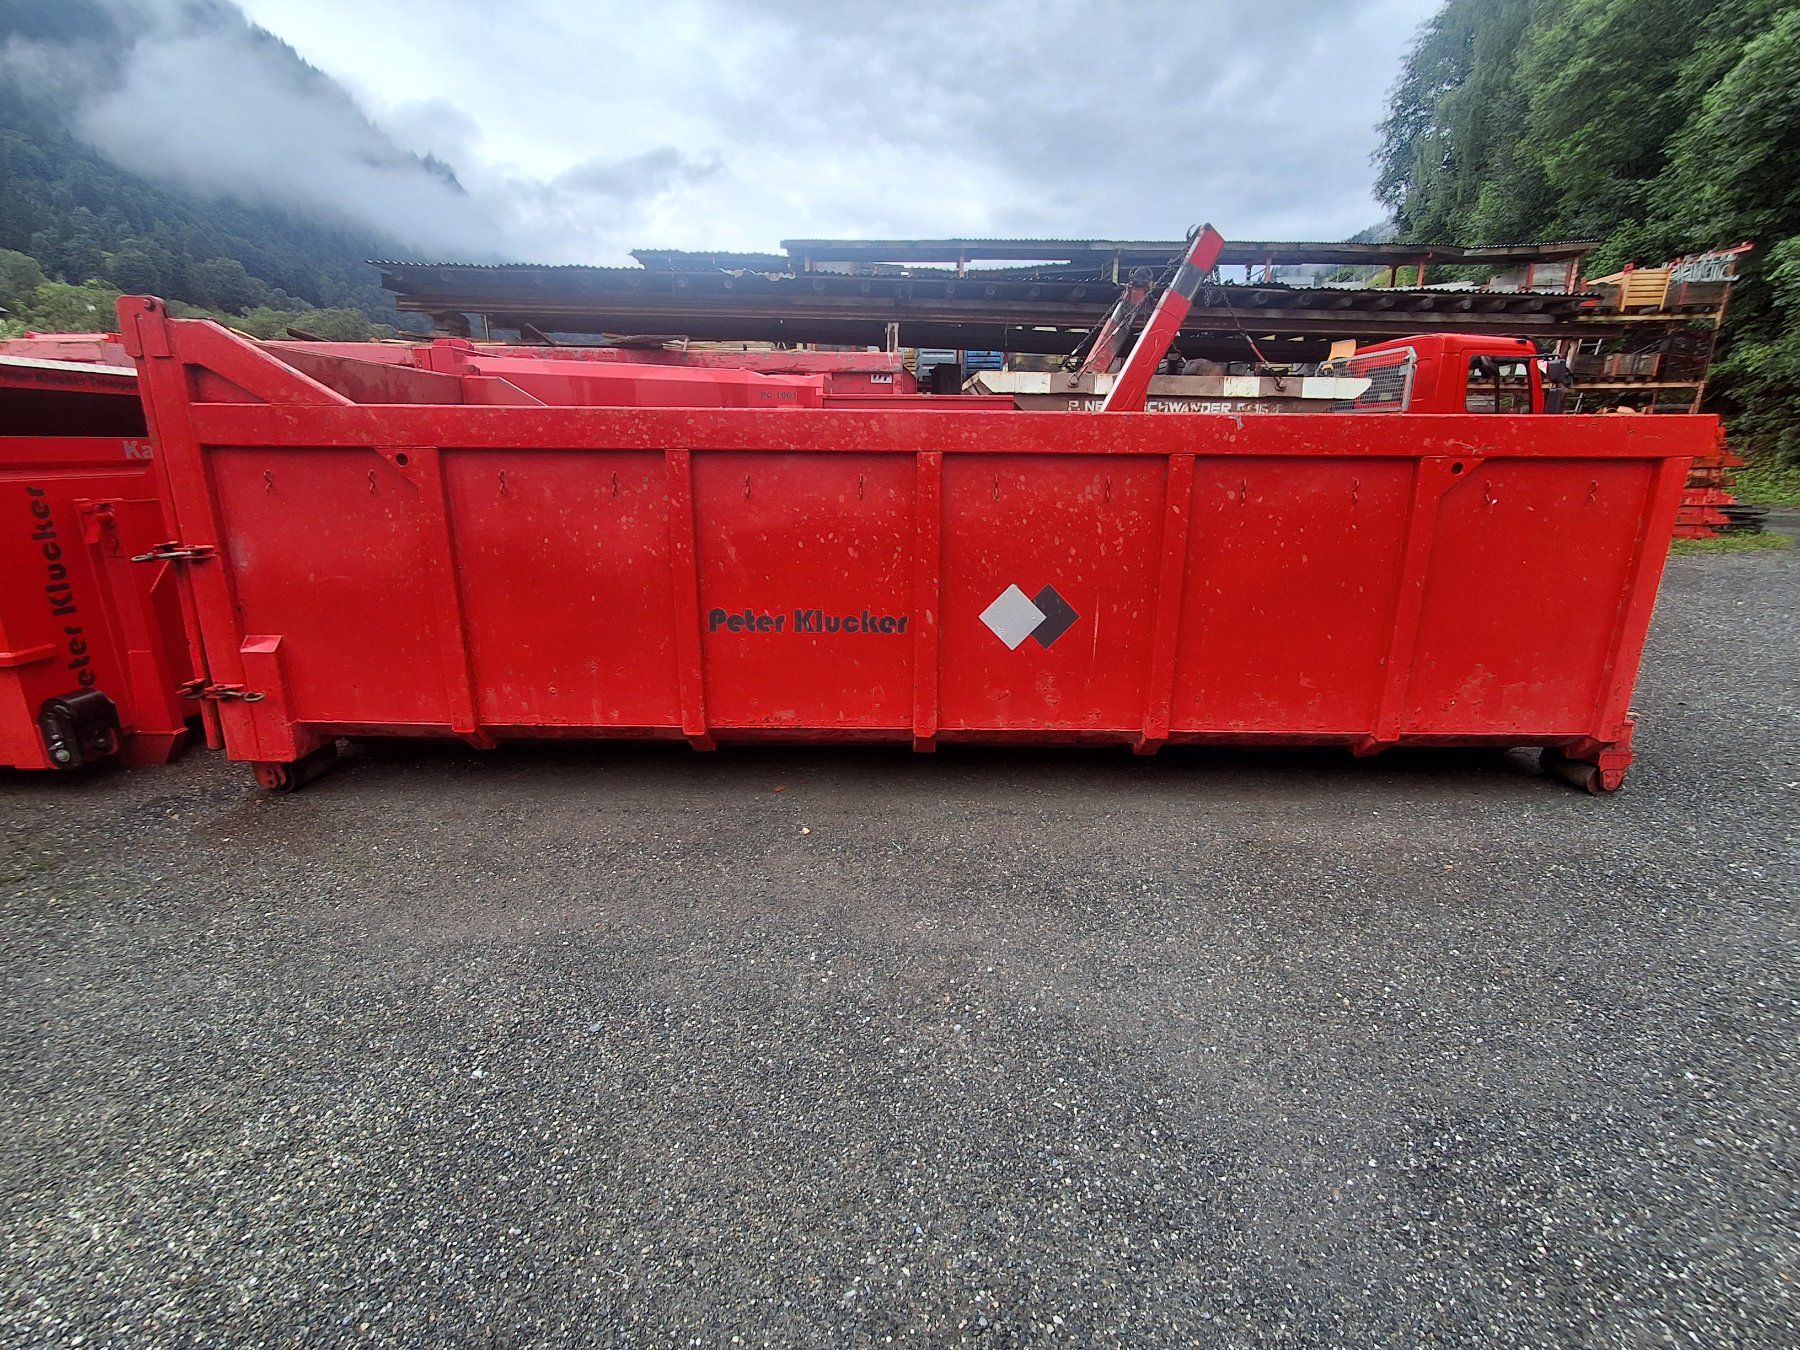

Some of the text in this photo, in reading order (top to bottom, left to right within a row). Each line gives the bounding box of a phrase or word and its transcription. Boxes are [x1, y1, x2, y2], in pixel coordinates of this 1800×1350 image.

[26, 486, 97, 688] eter Klucker
[709, 607, 909, 635] Peter Klucker
